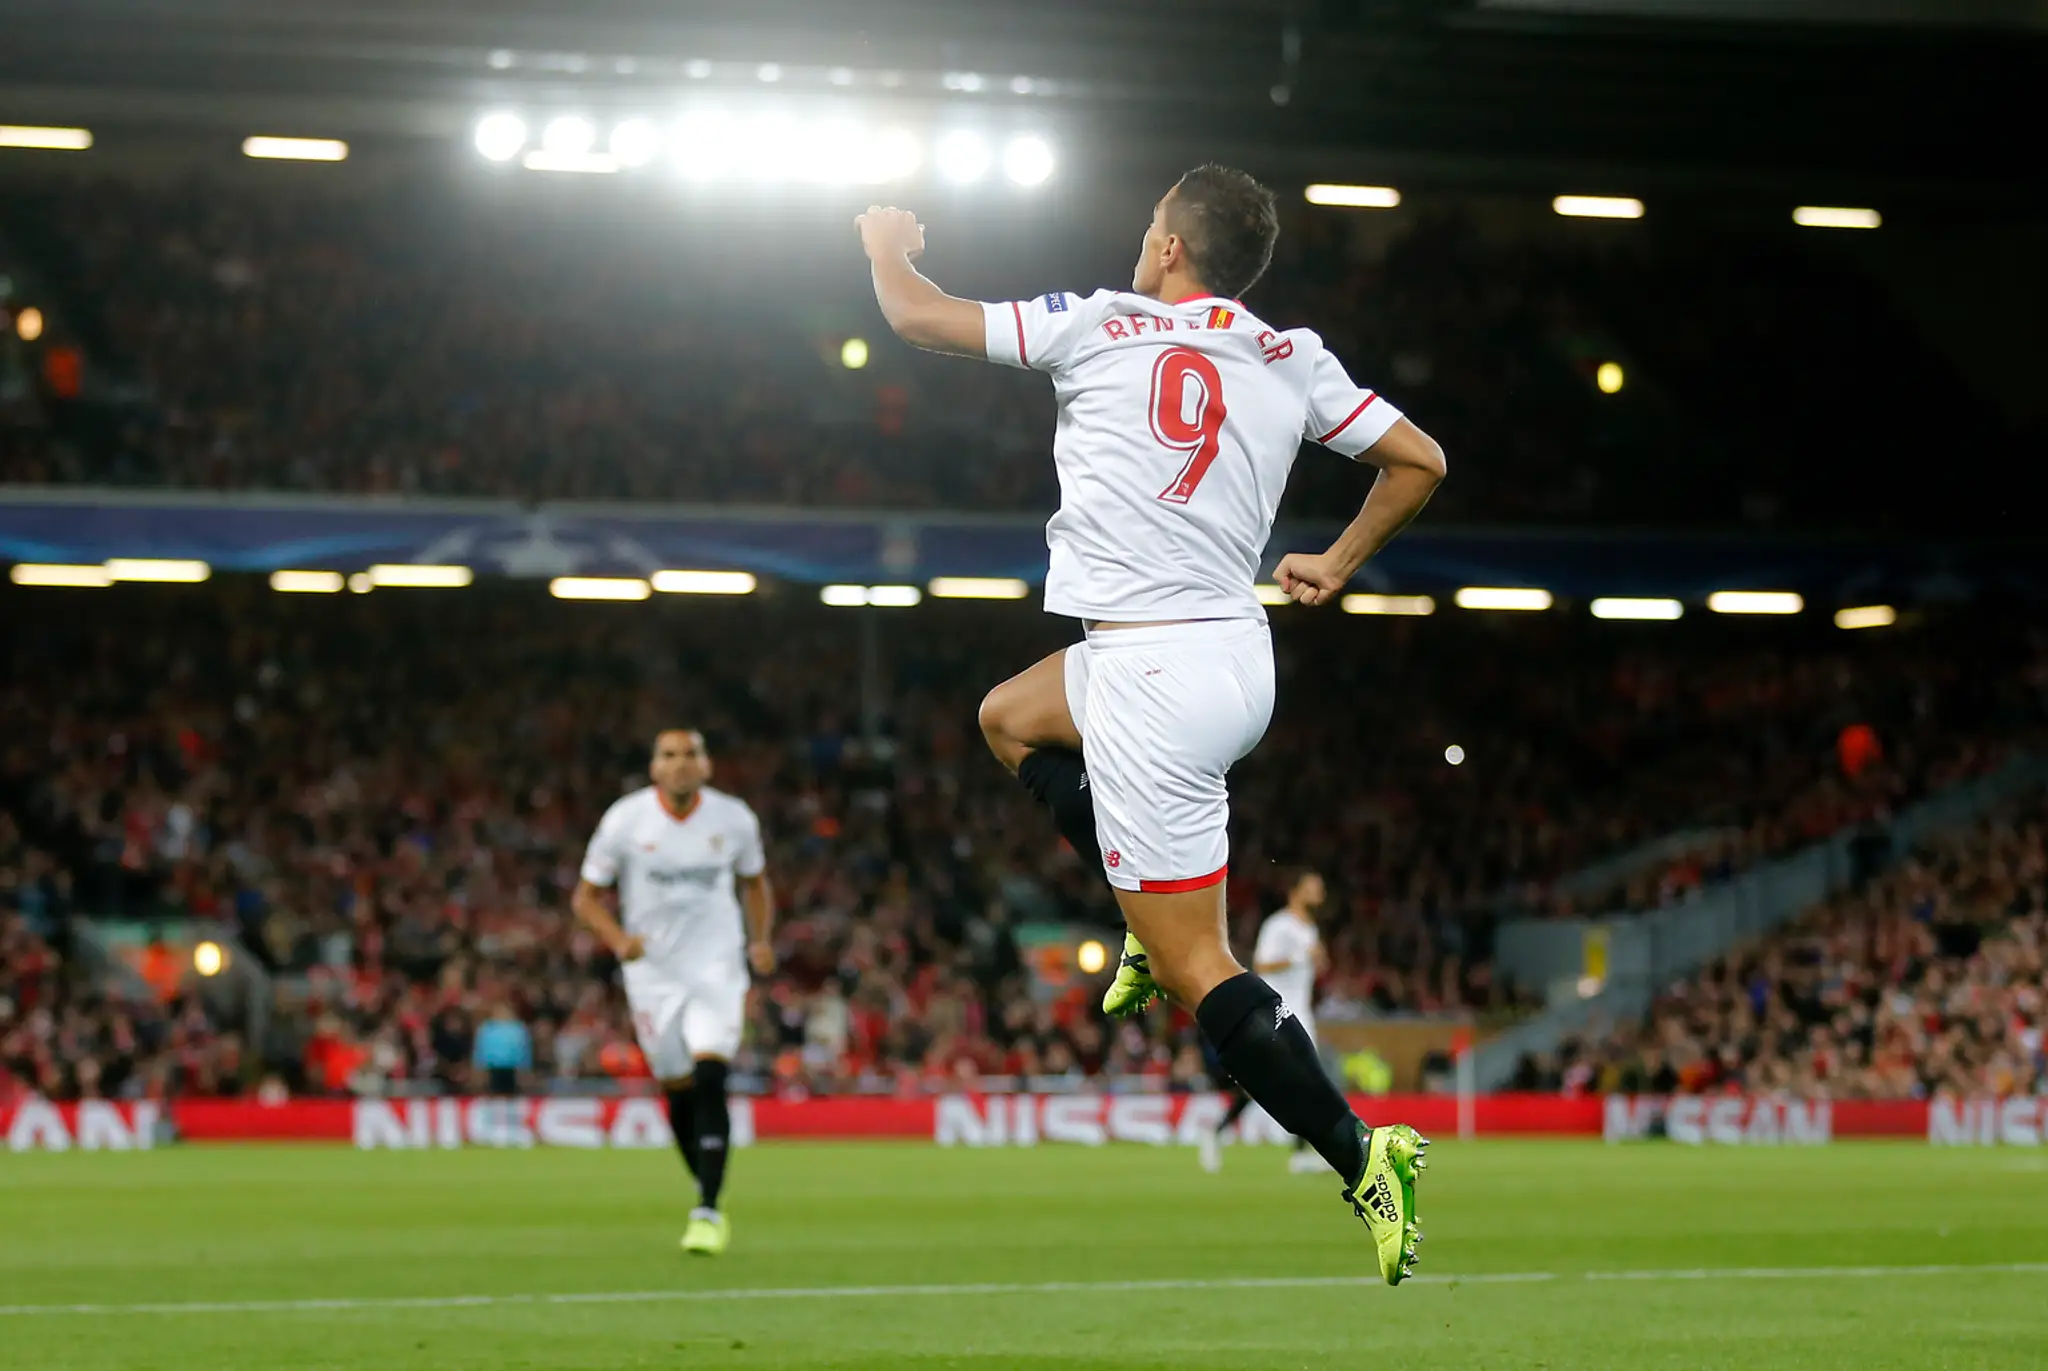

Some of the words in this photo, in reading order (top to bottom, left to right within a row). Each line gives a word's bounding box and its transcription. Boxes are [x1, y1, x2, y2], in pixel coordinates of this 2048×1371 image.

[1149, 346, 1226, 504] 9
[1929, 1097, 2048, 1147] NIS
[1376, 1173, 1398, 1222] adidas
